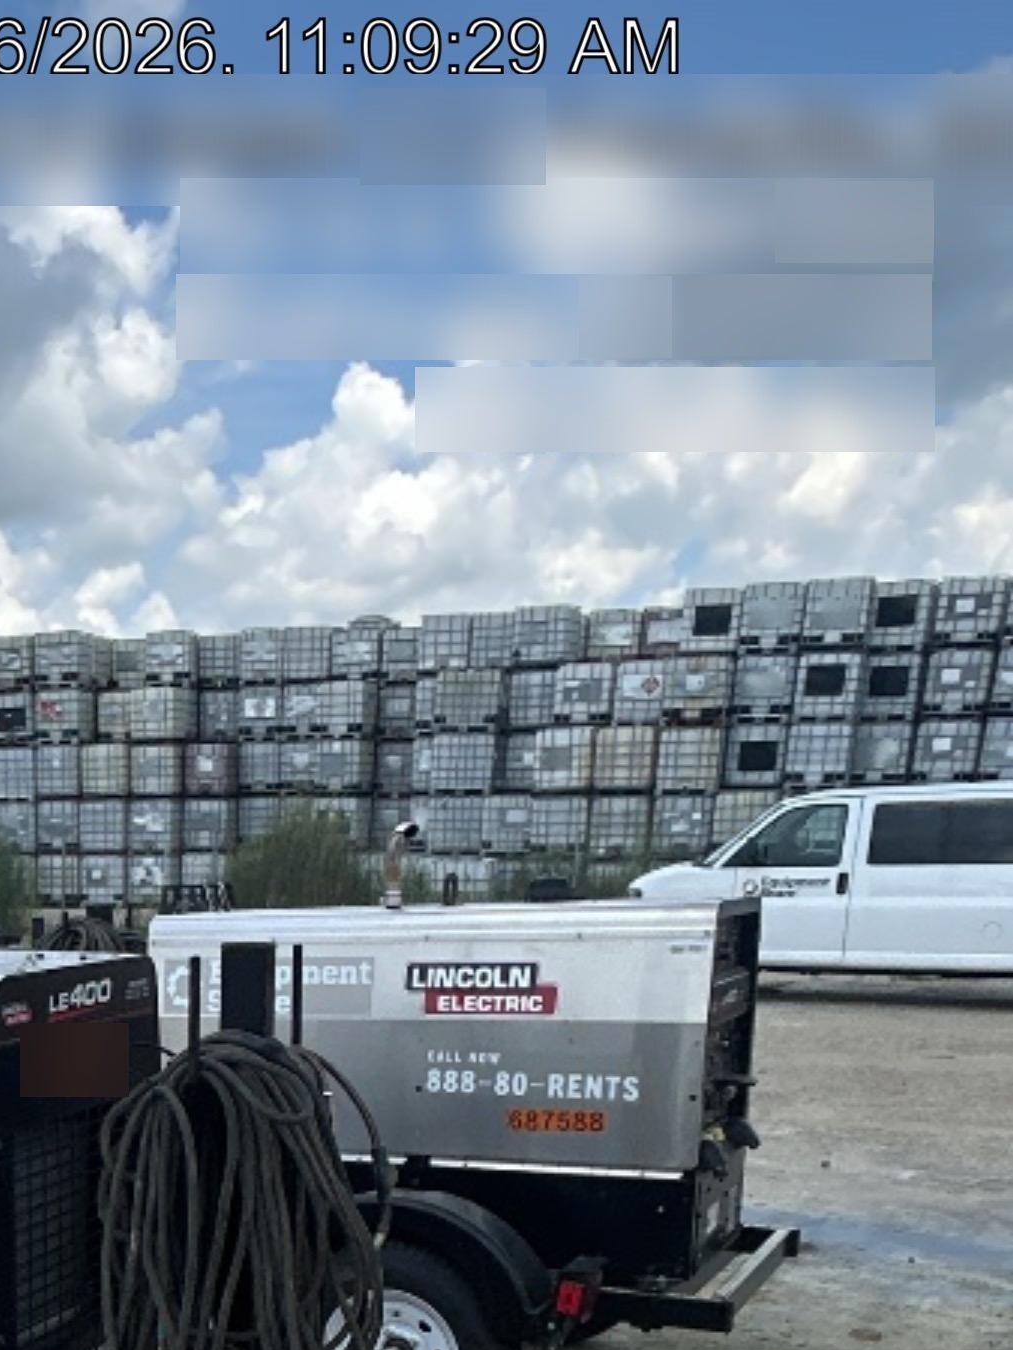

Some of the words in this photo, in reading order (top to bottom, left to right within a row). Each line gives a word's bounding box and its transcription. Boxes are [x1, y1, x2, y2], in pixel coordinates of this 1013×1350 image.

[412, 965, 531, 989] LINCOLN
[437, 994, 544, 1012] ELECTRIC
[427, 1050, 462, 1063] CALL
[426, 1068, 640, 1102] 888-80-RENTS
[509, 1109, 605, 1132] 687588
